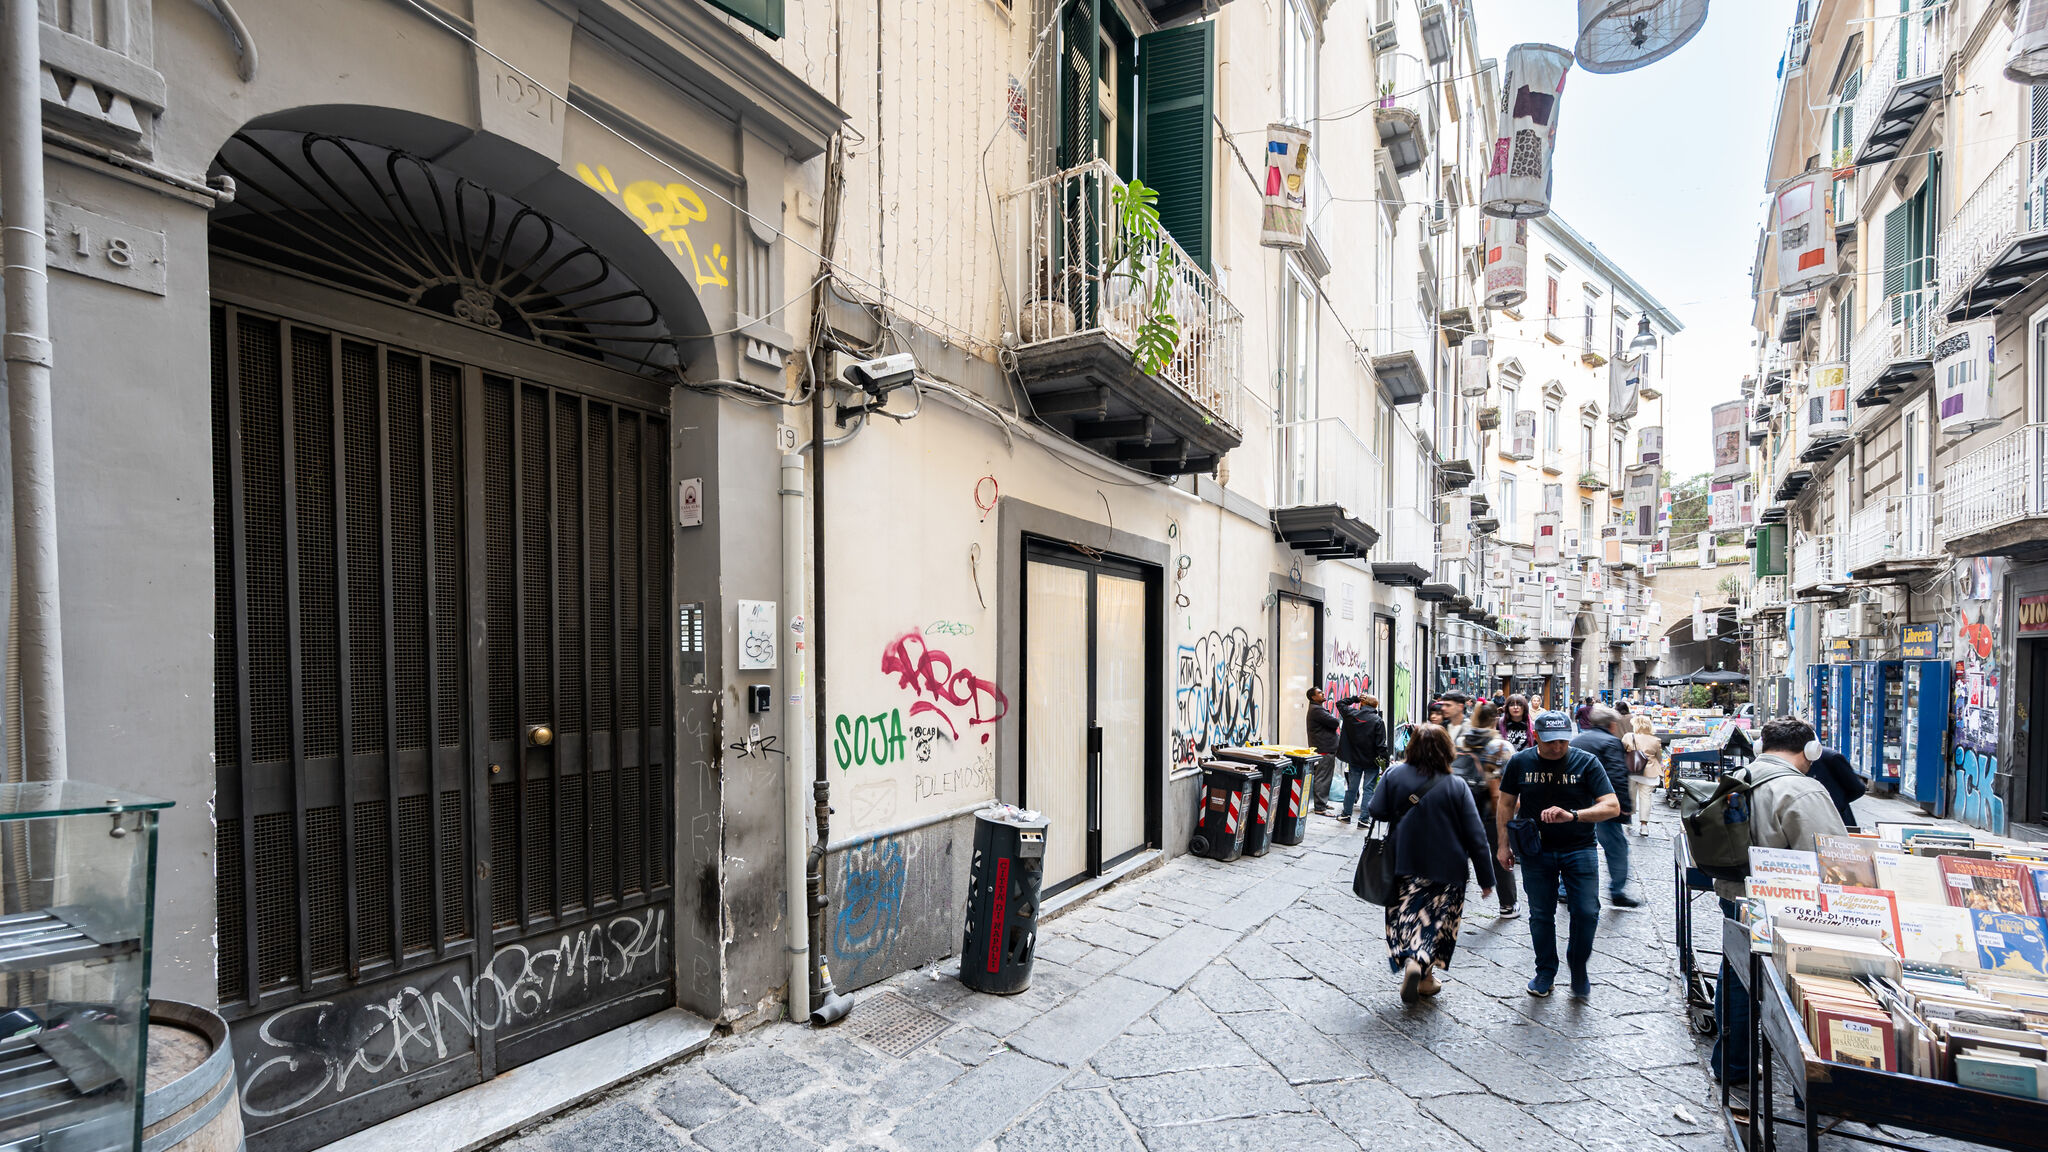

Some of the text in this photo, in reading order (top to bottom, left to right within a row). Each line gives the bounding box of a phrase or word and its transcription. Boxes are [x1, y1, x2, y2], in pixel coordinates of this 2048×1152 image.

[70, 226, 135, 267] 18
[776, 427, 795, 449] 19
[2019, 602, 2048, 625] VIN
[1903, 627, 1933, 643] Libreria
[834, 708, 907, 771] SOJA
[1525, 772, 1577, 784] MUSTNG
[1828, 837, 1861, 849] Presepe
[1821, 849, 1868, 862] napoletano
[1755, 865, 1820, 876] NAPOLETANA
[1762, 860, 1811, 870] CANZONE
[1752, 885, 1816, 901] FAVURITE!
[1853, 1024, 1869, 1033] 2,00
